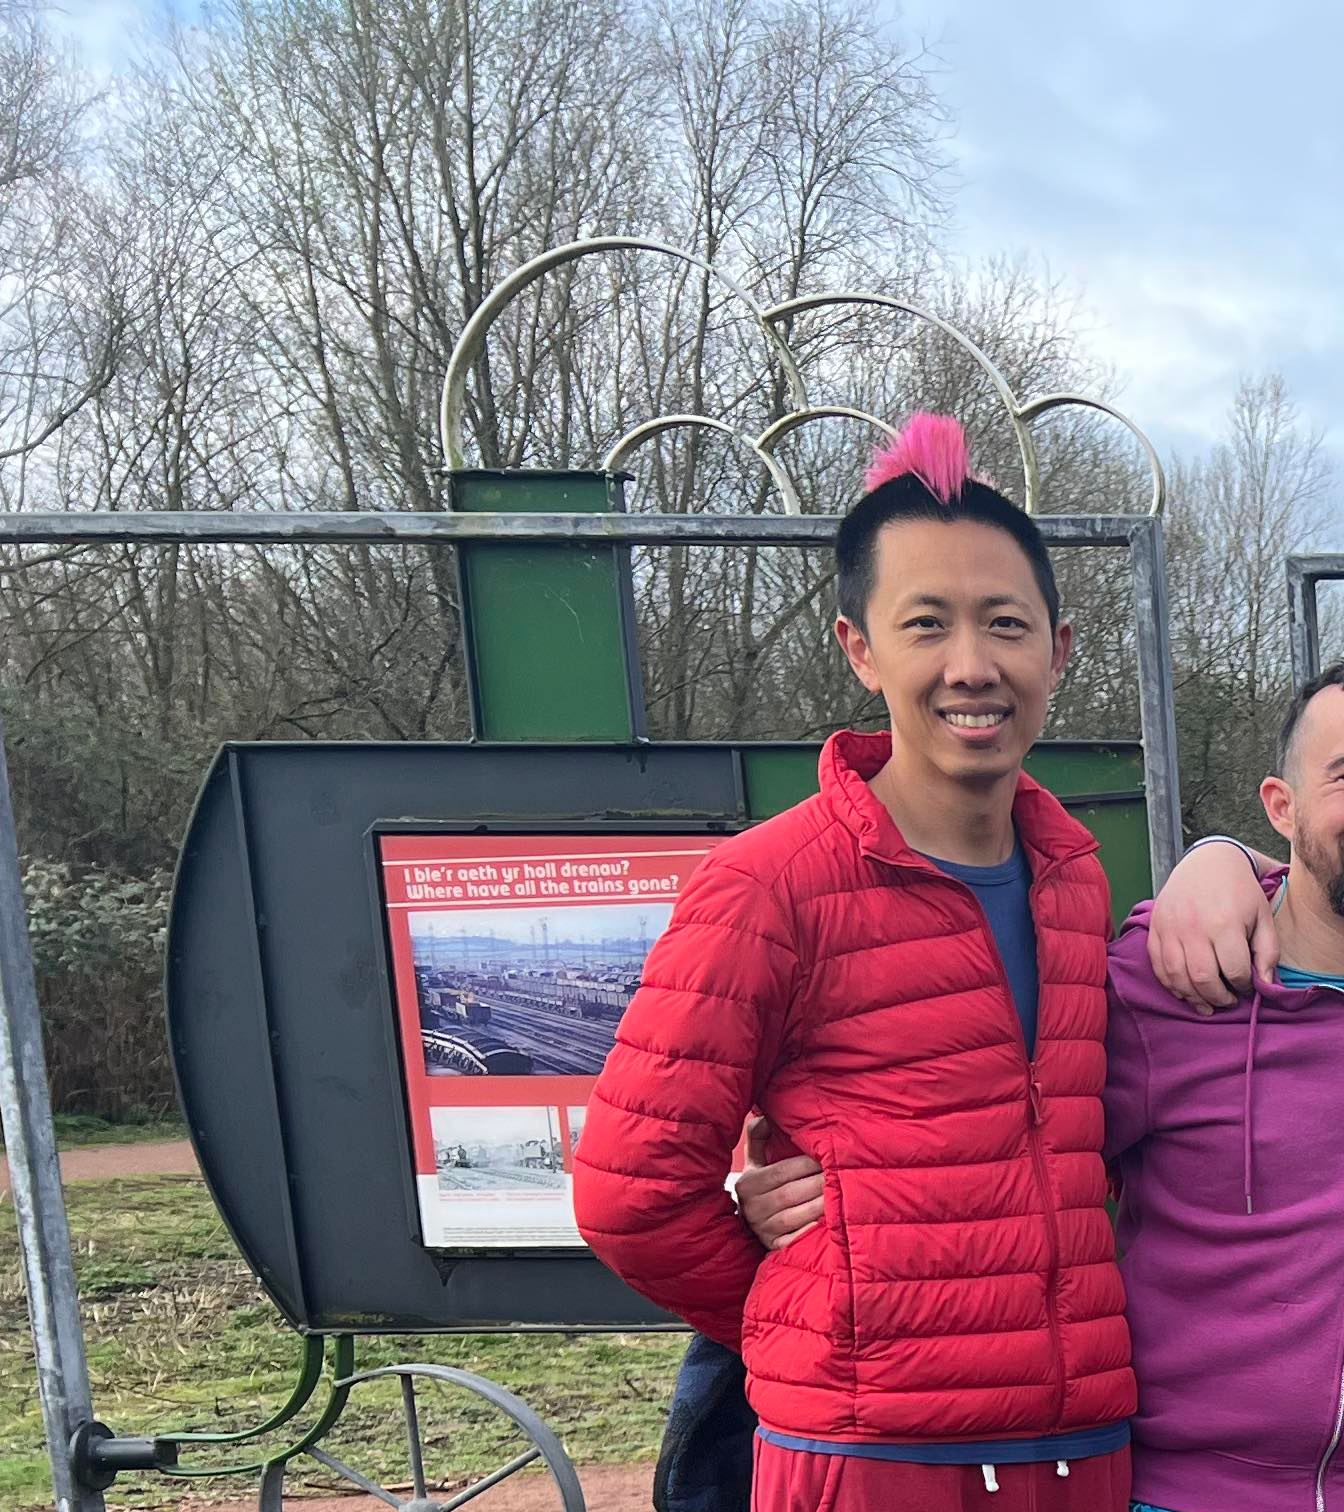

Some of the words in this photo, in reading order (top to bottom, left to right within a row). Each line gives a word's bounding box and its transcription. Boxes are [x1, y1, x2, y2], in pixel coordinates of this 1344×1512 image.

[404, 868, 410, 883] I
[414, 866, 453, 883] ble'r
[457, 864, 497, 881] aeth
[501, 868, 520, 883] yr
[524, 863, 557, 879] holl
[560, 860, 629, 878] drenau?
[406, 883, 462, 900] Where
[467, 882, 511, 898] have
[515, 880, 536, 896] all
[541, 879, 570, 895] the
[573, 877, 624, 894] trains
[628, 875, 679, 895] gone?
